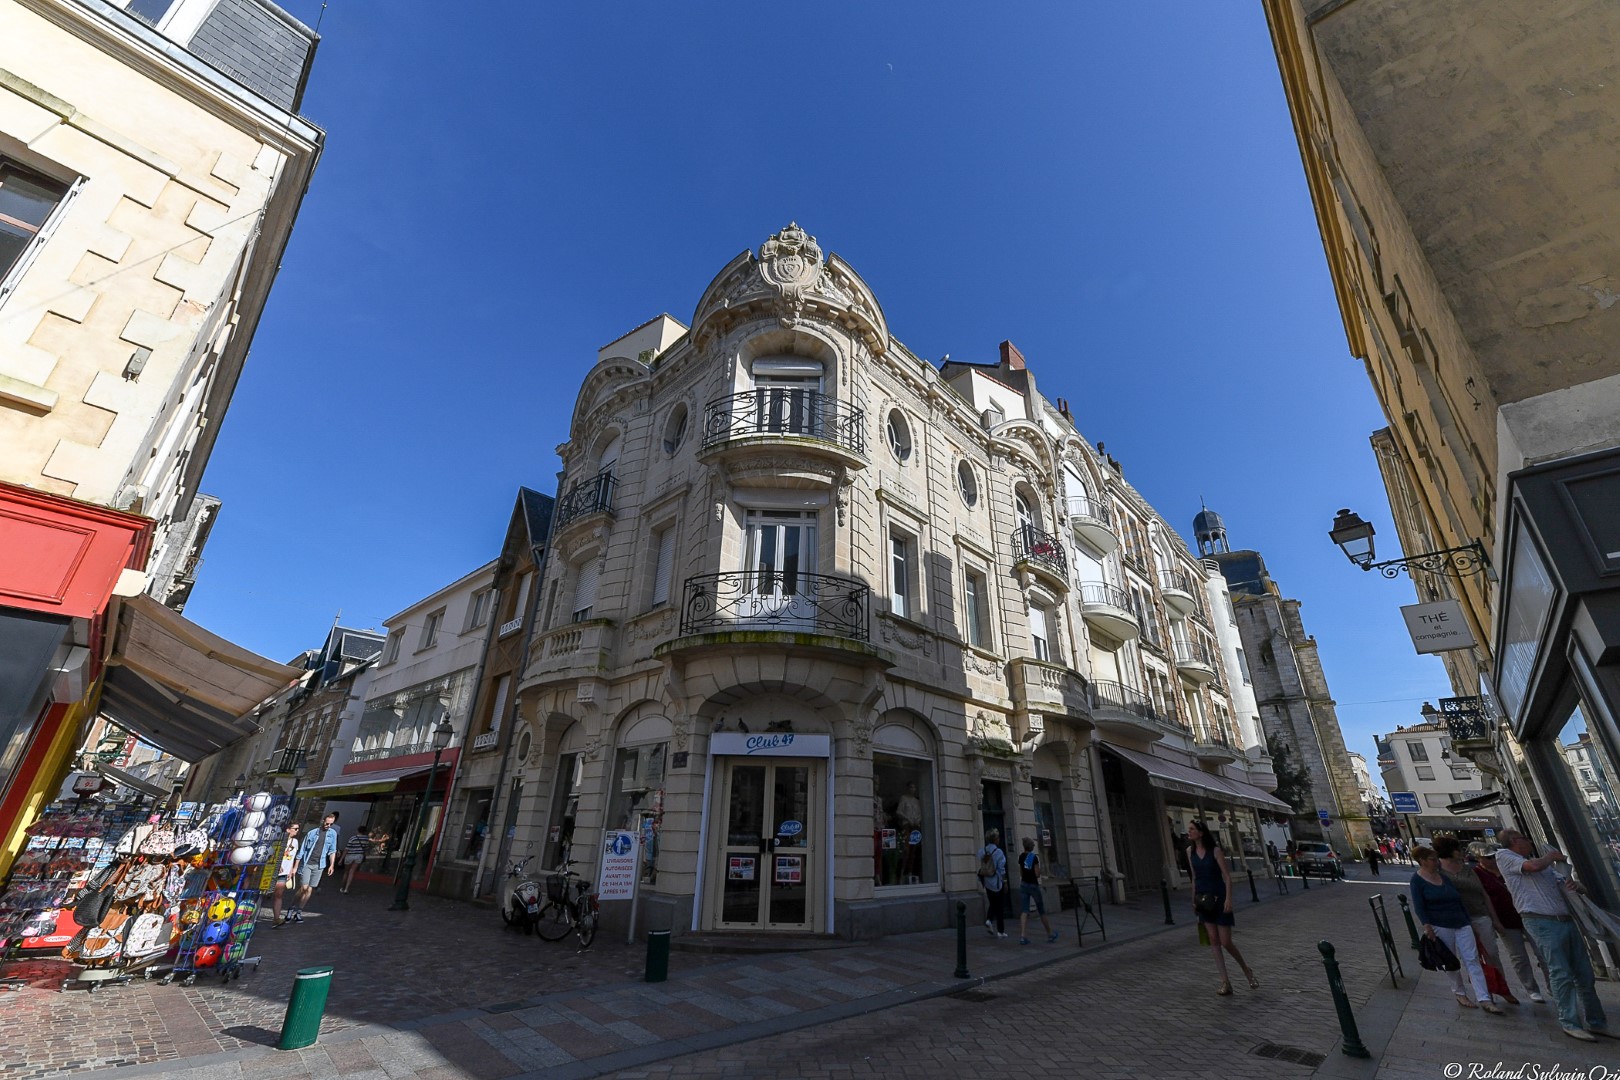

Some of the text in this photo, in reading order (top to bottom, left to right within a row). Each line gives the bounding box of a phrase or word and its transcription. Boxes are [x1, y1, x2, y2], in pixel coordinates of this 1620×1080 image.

[1418, 611, 1449, 624] THÉ
[746, 733, 795, 749] Club 47
